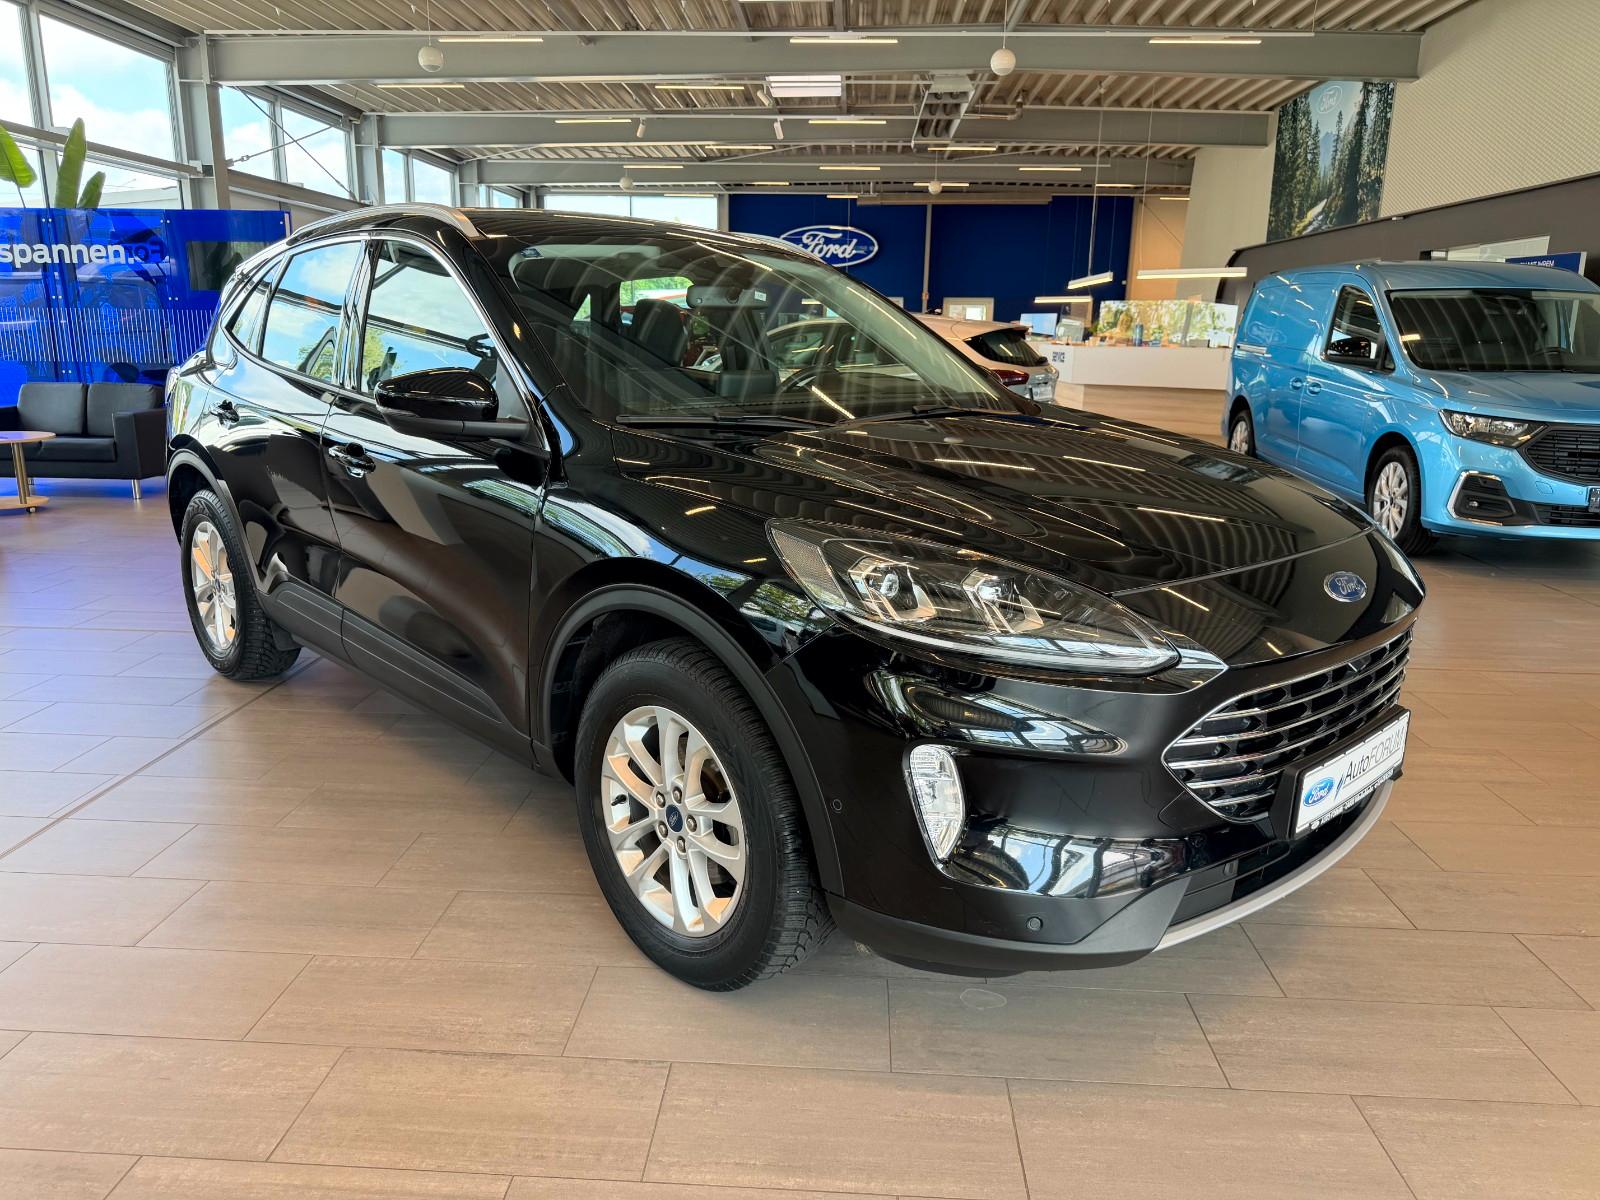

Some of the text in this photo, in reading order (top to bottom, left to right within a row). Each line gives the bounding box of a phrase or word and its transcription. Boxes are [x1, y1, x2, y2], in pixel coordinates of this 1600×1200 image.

[801, 231, 858, 258] Ford
[1335, 576, 1361, 595] Ford
[1308, 781, 1330, 804] Ford
